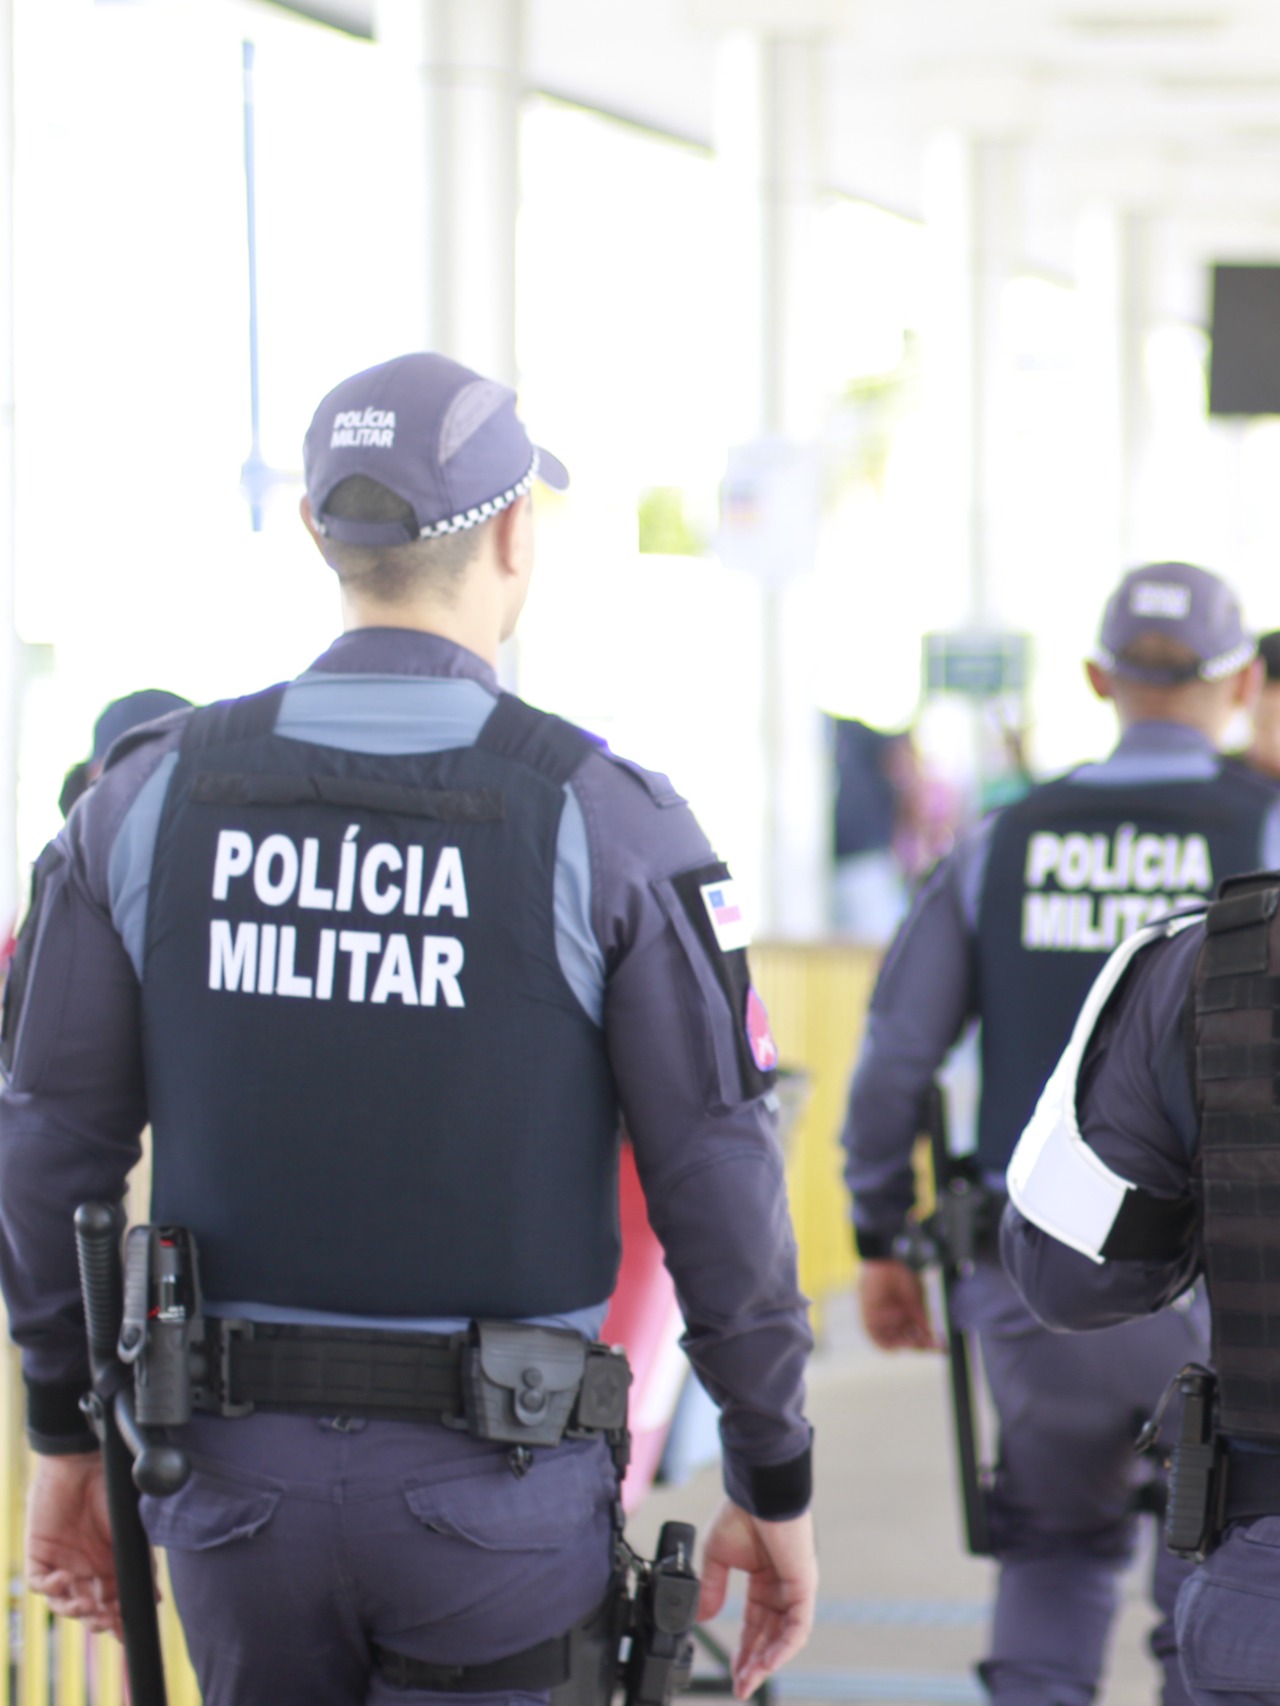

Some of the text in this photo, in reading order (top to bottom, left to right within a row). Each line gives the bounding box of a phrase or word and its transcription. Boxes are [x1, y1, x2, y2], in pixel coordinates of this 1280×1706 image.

[330, 429, 395, 448] MILITAR
[334, 406, 396, 429] POLÍCIA
[212, 824, 469, 918] POLÍCIA
[1026, 824, 1212, 890] POLÍCIA
[1022, 891, 1208, 949] MILIT
[209, 919, 465, 1008] MILITAR
